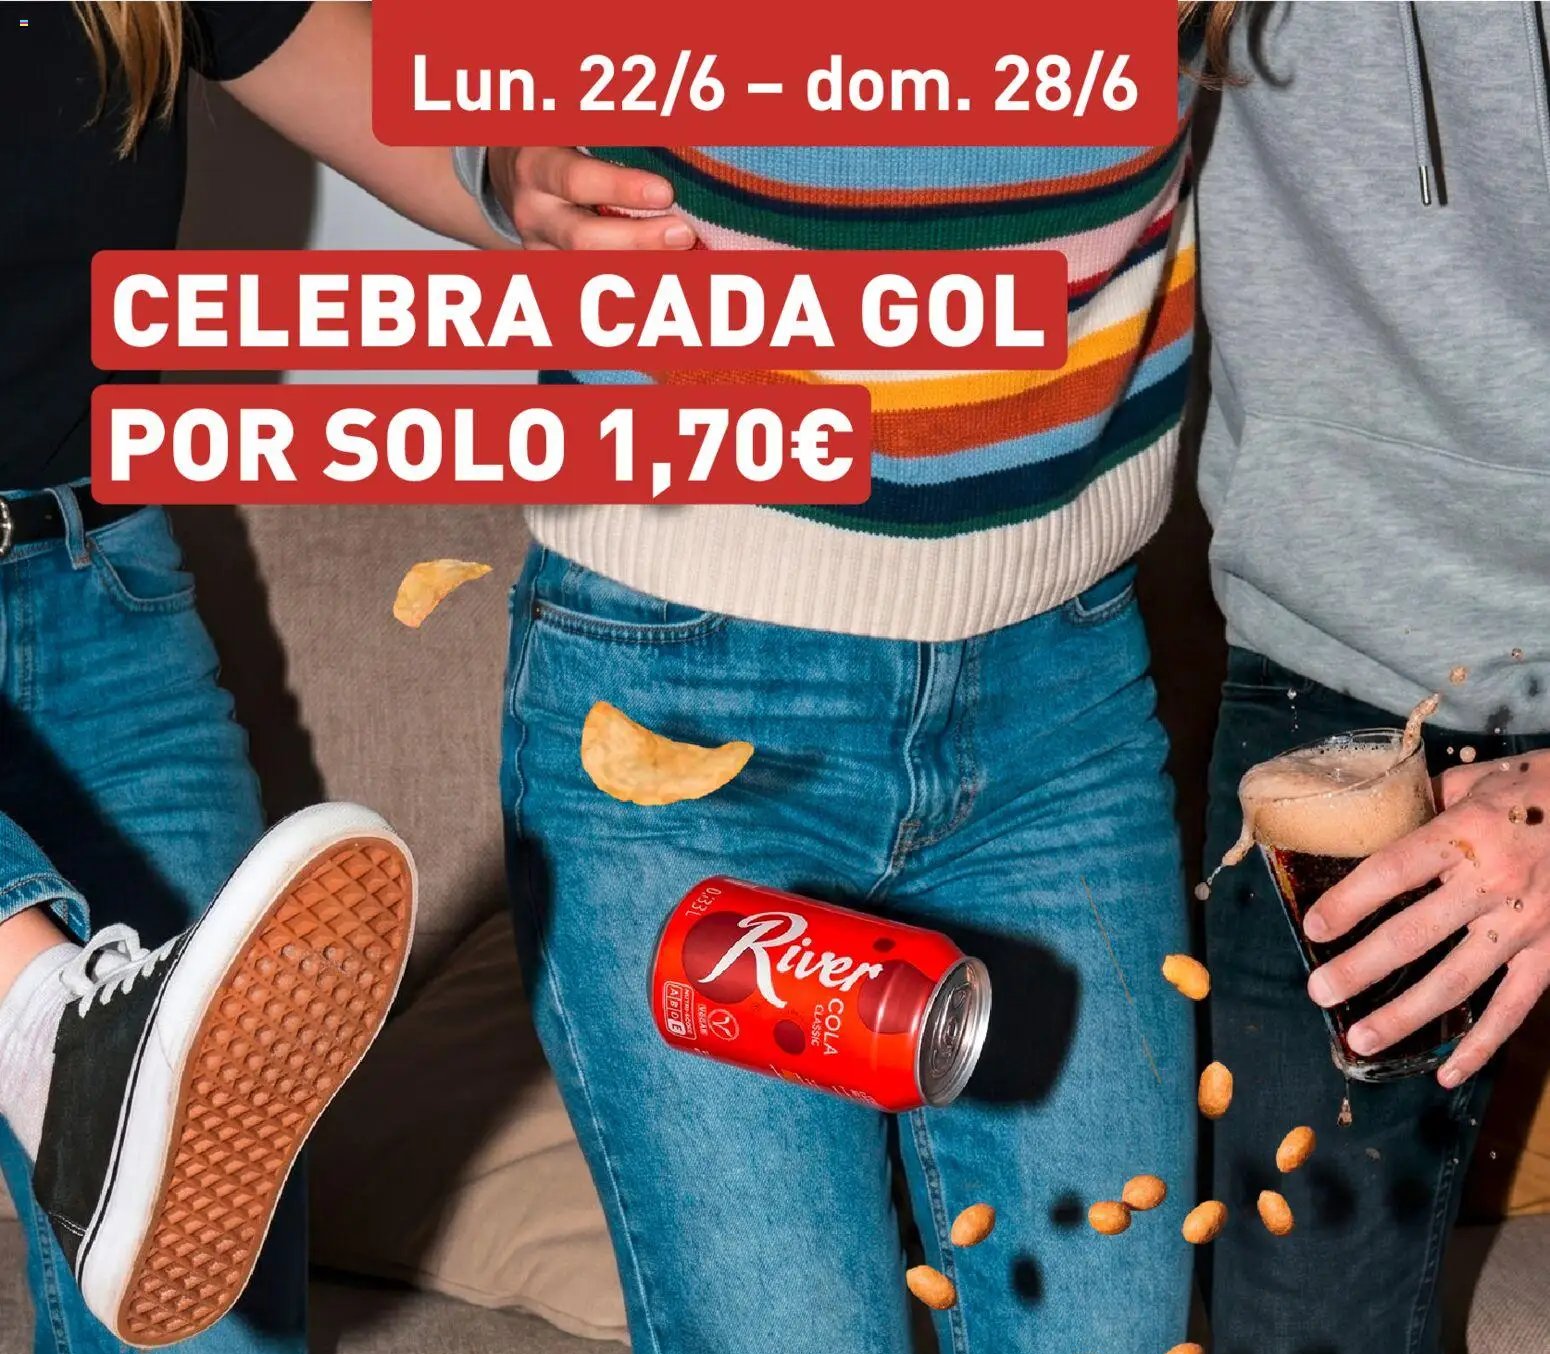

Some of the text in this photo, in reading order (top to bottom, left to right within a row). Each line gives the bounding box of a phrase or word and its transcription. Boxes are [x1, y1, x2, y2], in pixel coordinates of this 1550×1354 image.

[698, 911, 884, 1009] River
[810, 1004, 824, 1047] CLASSIC
[823, 998, 844, 1056] COLA
